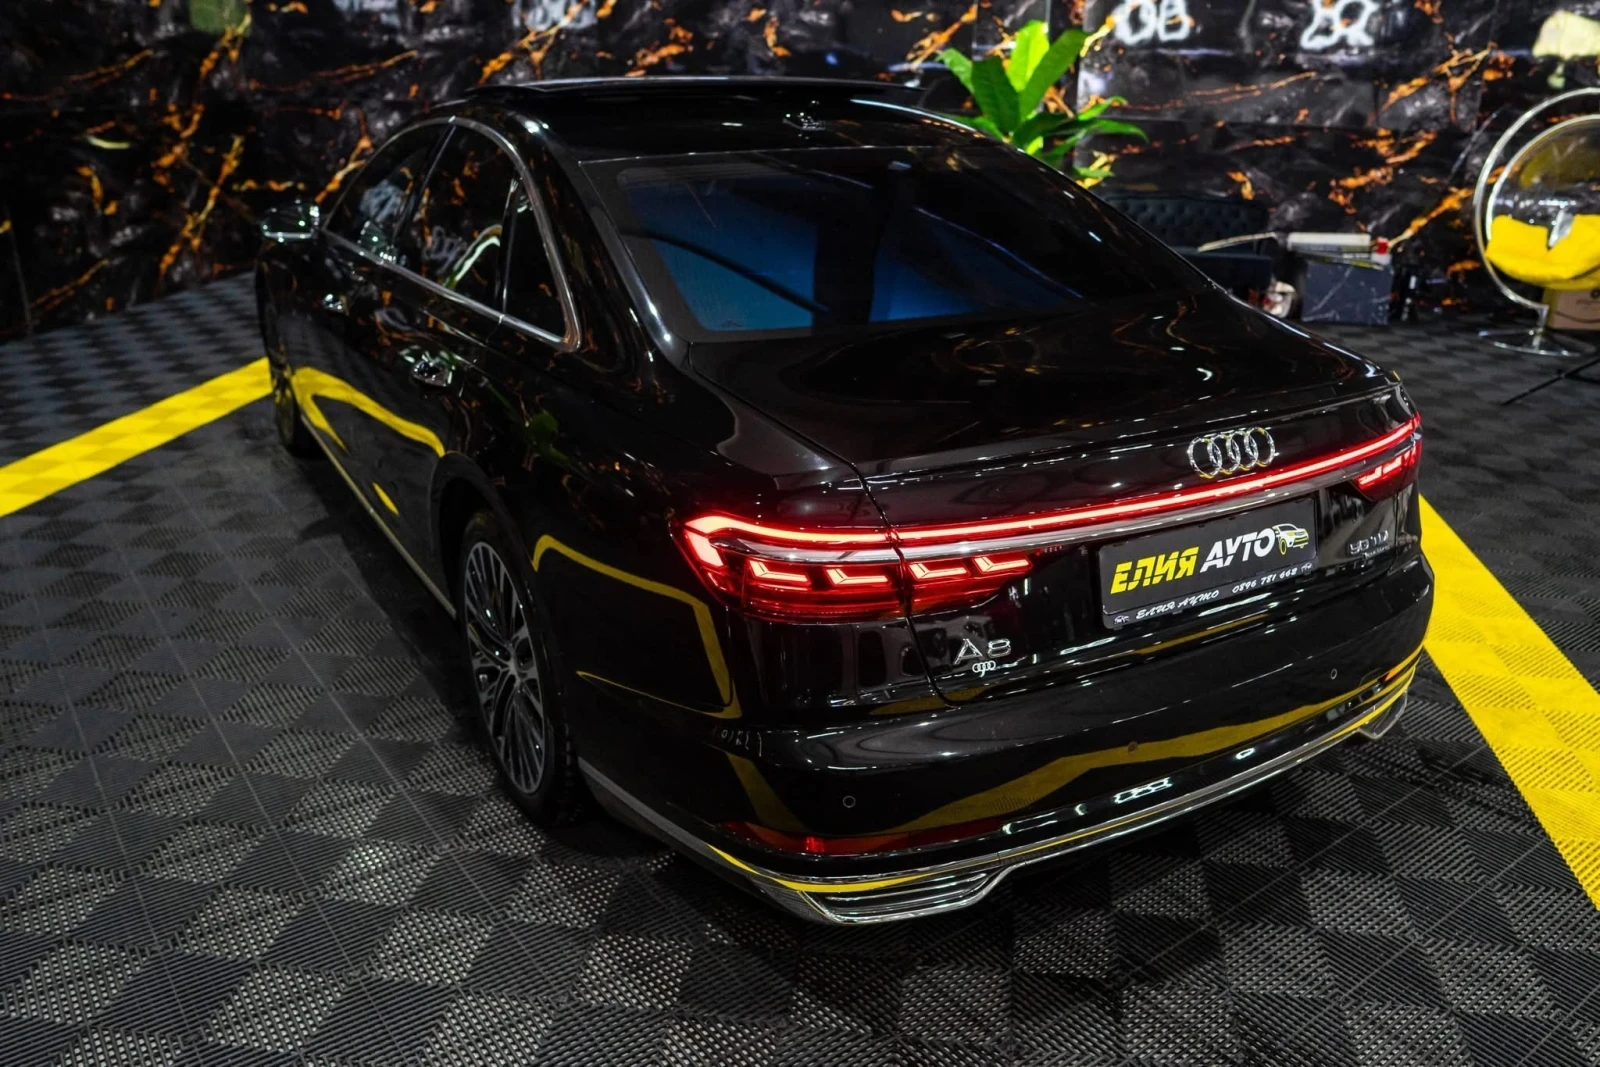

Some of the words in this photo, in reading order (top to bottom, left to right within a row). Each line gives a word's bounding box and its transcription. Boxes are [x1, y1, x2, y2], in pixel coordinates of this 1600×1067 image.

[1110, 546, 1200, 594] ЕЛИЯ
[1200, 528, 1276, 573] АУТО
[1231, 579, 1257, 594] 0896
[1260, 573, 1277, 586] 781
[953, 638, 1012, 665] A8
